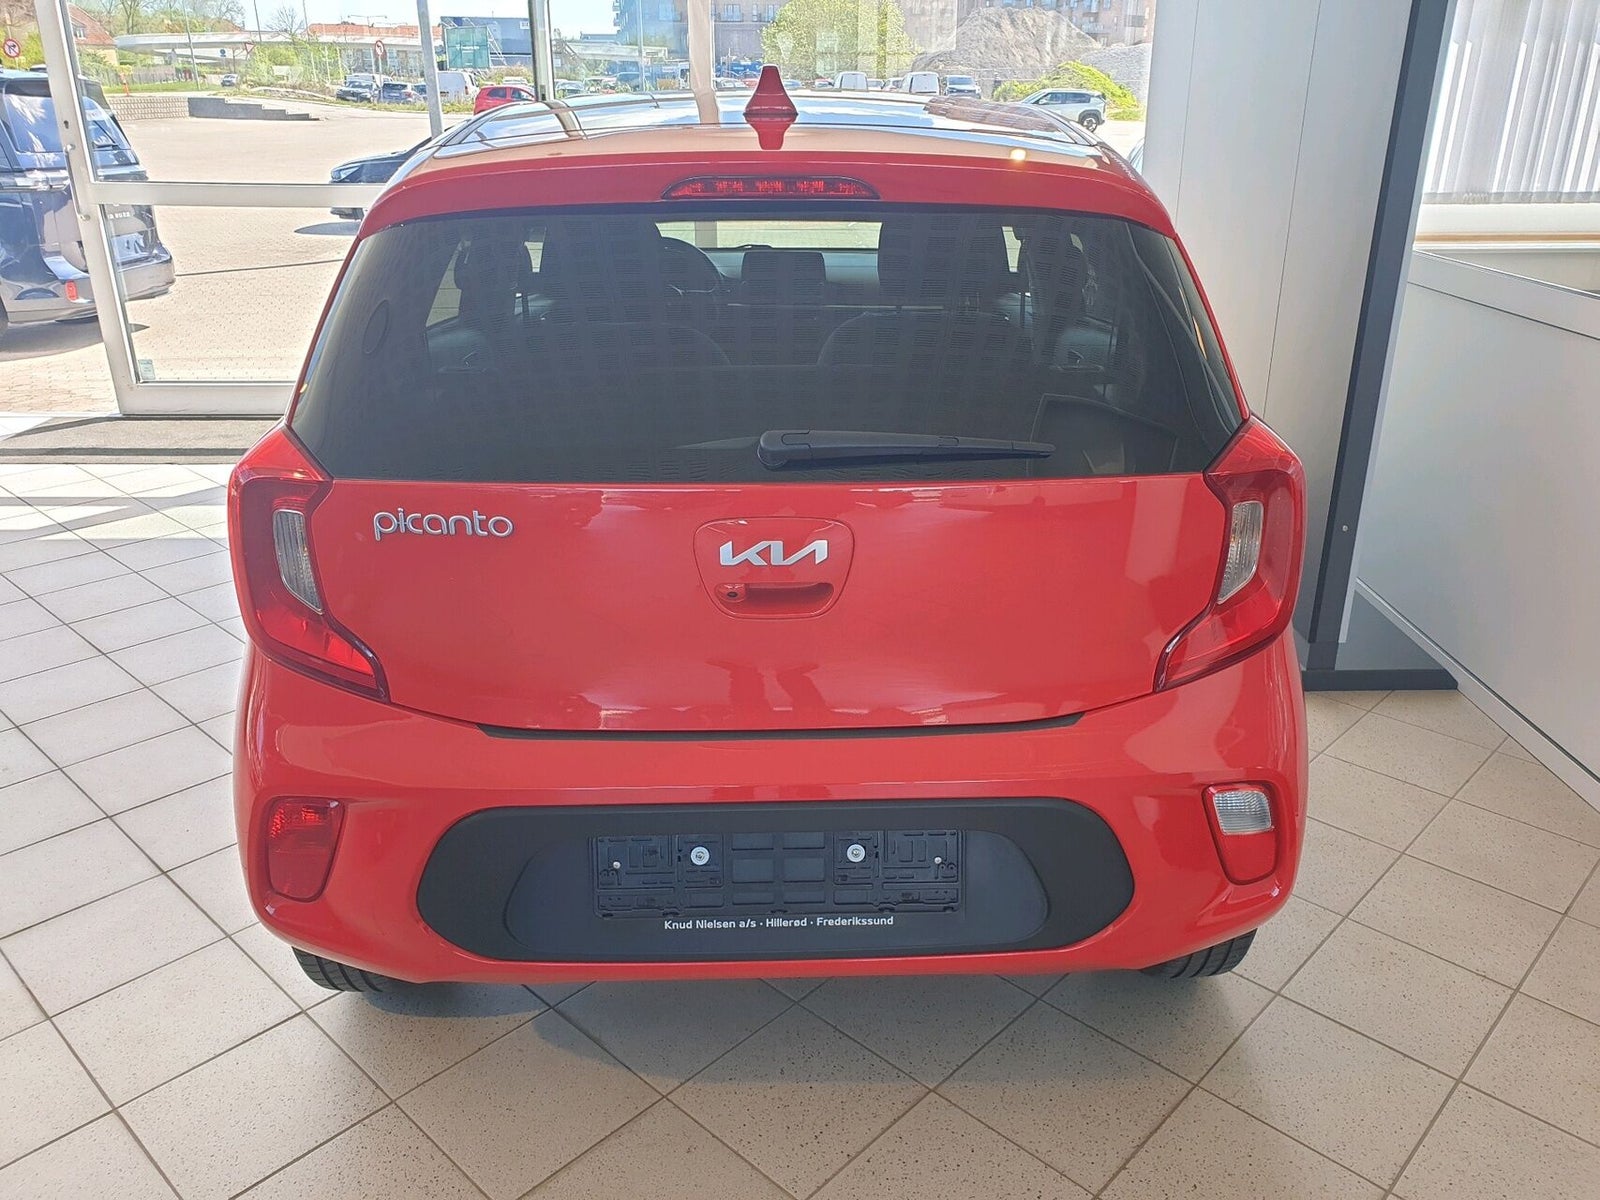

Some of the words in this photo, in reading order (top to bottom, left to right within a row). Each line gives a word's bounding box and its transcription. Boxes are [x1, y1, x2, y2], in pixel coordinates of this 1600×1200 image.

[373, 507, 514, 541] picanto
[719, 539, 829, 566] KIA
[664, 919, 693, 930] Knud
[695, 918, 736, 929] Nielsen
[738, 918, 757, 929] a/s
[765, 917, 808, 928] Hillerød
[816, 916, 894, 928] Frederikssund
